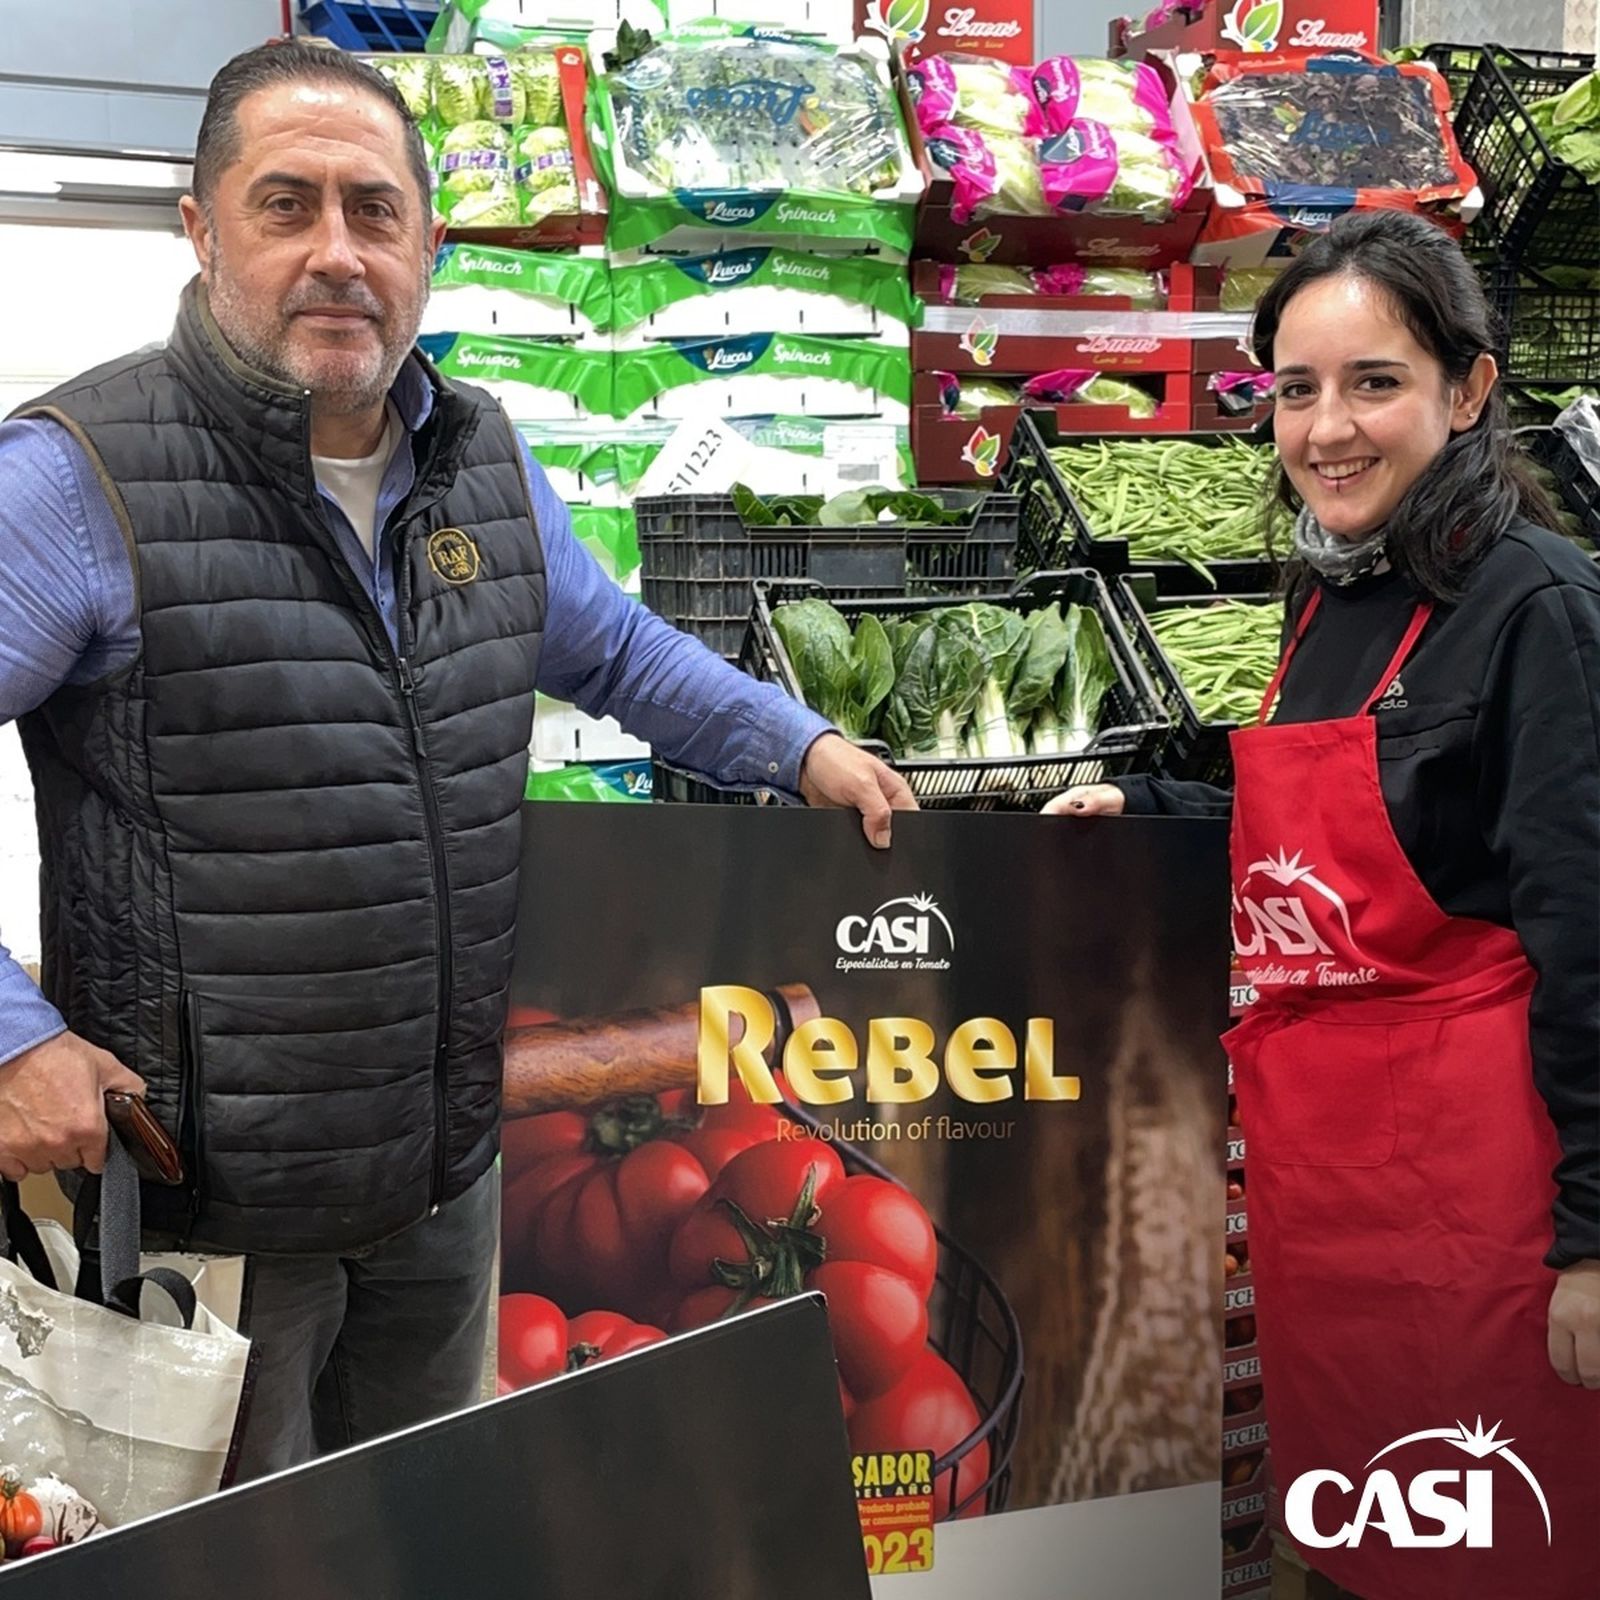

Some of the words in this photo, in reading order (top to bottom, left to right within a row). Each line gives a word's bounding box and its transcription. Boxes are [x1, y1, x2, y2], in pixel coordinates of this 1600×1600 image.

[937, 7, 1022, 38] Lucas
[1288, 19, 1368, 48] Lucas
[705, 202, 756, 222] Lucas
[775, 202, 838, 223] Spinach
[1290, 206, 1333, 225] Lucas
[458, 252, 523, 275] Spinach
[707, 260, 753, 283] Lucas
[771, 256, 831, 280] Spinach
[456, 346, 522, 369] Spinach
[707, 348, 753, 370] Lucas
[773, 343, 832, 366] Spinach
[835, 915, 930, 954] CASI
[835, 957, 900, 973] Especialistas
[915, 957, 951, 970] Tomate
[1315, 960, 1380, 986] Tomate
[777, 1117, 901, 1142] Revolution
[906, 1116, 932, 1141] of
[936, 1115, 1017, 1140] flavour
[851, 1452, 931, 1487] SABOR
[895, 1483, 932, 1497] AÑO
[863, 1527, 934, 1575] 023
